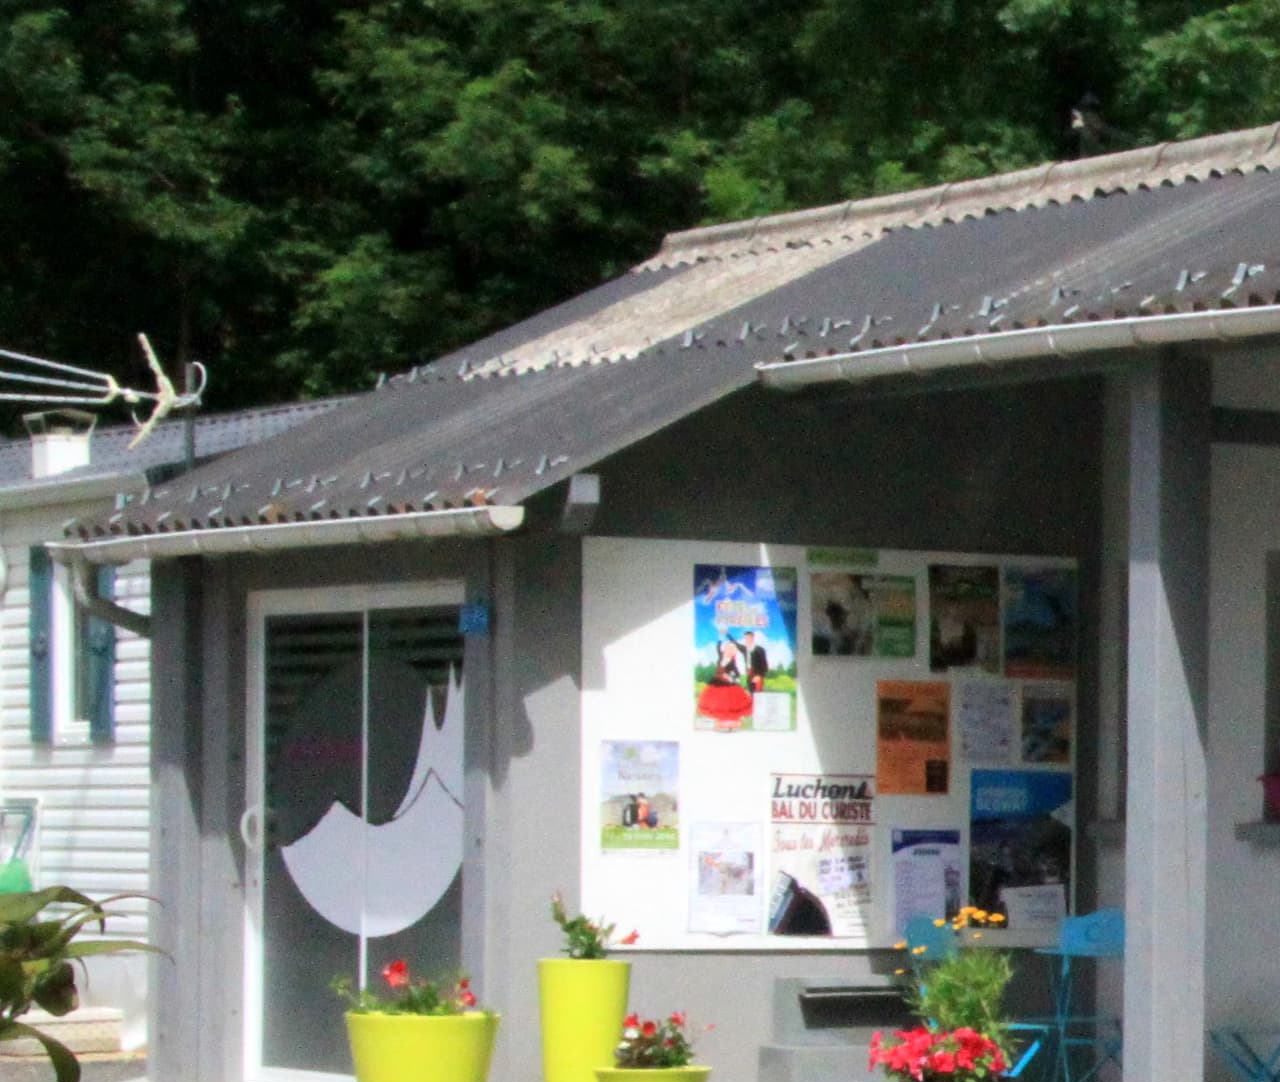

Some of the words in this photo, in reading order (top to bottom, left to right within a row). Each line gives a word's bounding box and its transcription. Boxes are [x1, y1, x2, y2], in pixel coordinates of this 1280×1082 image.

[772, 801, 793, 818] BAL
[799, 801, 817, 819] DU
[823, 802, 871, 820] CURISTE
